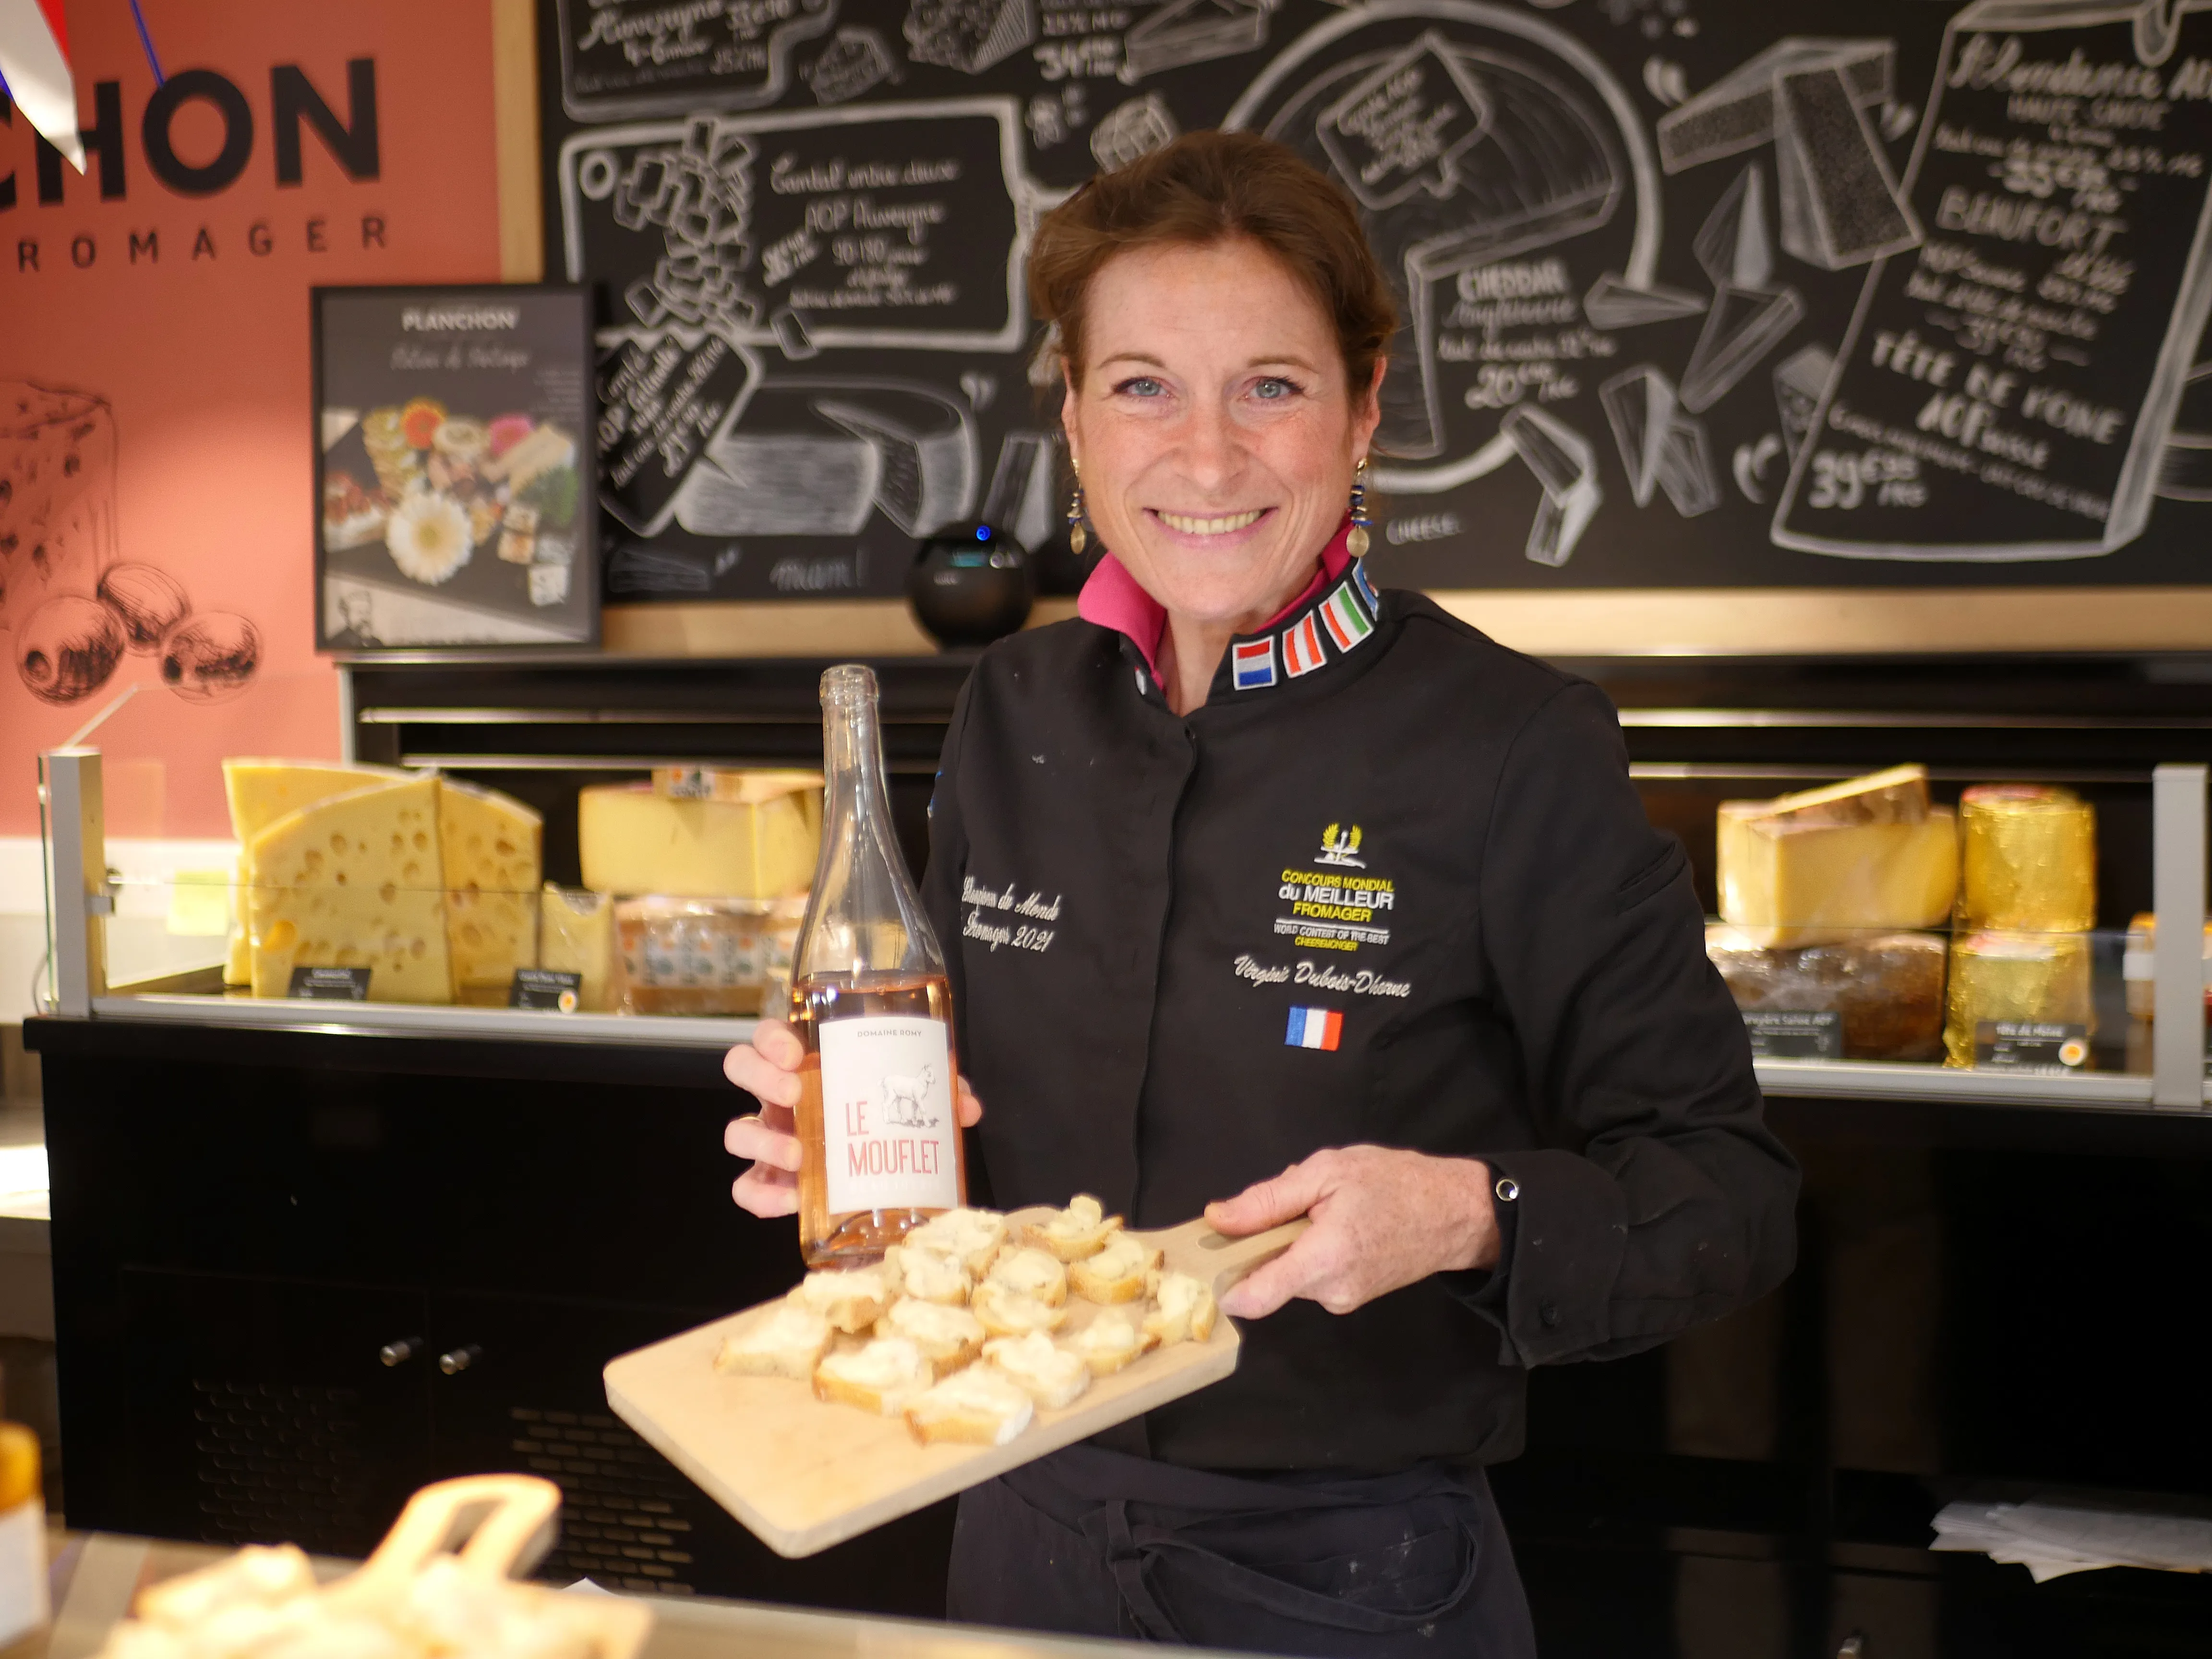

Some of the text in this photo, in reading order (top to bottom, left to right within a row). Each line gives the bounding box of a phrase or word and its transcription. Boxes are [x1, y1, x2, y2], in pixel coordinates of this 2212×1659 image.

[0, 59, 380, 214] HON
[805, 194, 950, 246] AOP Auvergne
[1935, 183, 2129, 259] BEAUFORT
[1457, 257, 1569, 302] CHEDDAR
[400, 306, 519, 332] PLANCHON
[1871, 329, 1959, 388] TÊTE
[1964, 363, 2019, 409] DE
[1915, 389, 2000, 447] AOP
[1278, 883, 1394, 910] du MEILLEUR
[1281, 868, 1395, 893] CONCOURS MONDIAL
[1293, 902, 1373, 922] FROMAGER
[1010, 924, 1056, 953] 2021
[1337, 930, 1350, 940] OF
[1350, 931, 1367, 942] THE
[1367, 933, 1390, 945] BEST
[1234, 954, 1412, 998] Virginie Dubois-Dhorne
[857, 1029, 898, 1037] DOMAINE
[845, 1101, 870, 1137] LE
[848, 1140, 939, 1178] MOUFLET
